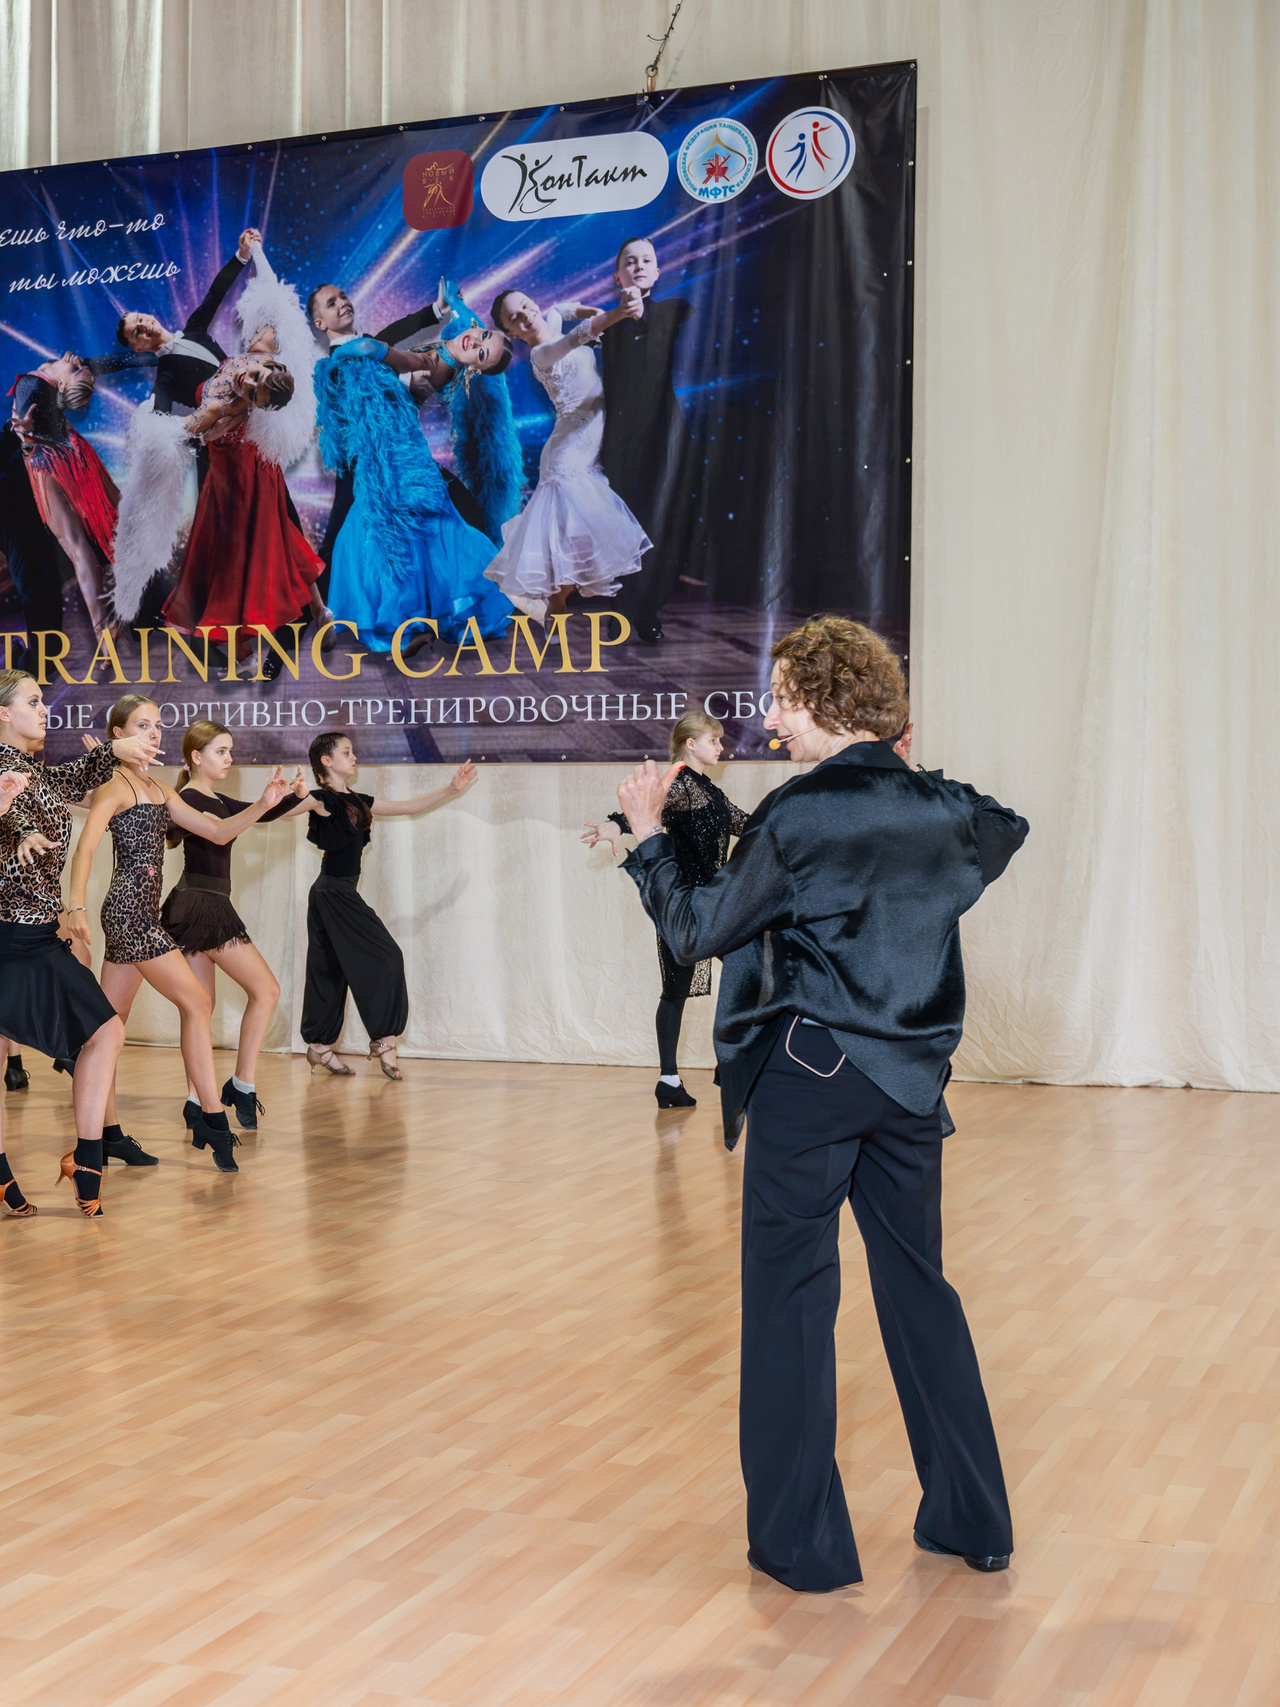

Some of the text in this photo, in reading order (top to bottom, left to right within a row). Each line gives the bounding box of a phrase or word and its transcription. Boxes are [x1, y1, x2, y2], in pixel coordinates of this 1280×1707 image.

[735, 163, 753, 188] СПОРТА
[698, 184, 737, 199] МФТС
[55, 213, 166, 241] что-то
[9, 272, 59, 294] ты
[61, 261, 181, 287] можешь
[391, 611, 631, 679] CAMP
[106, 691, 688, 728] ОРТИВНО-ТРЕНИРОВОЧНЫЕ
